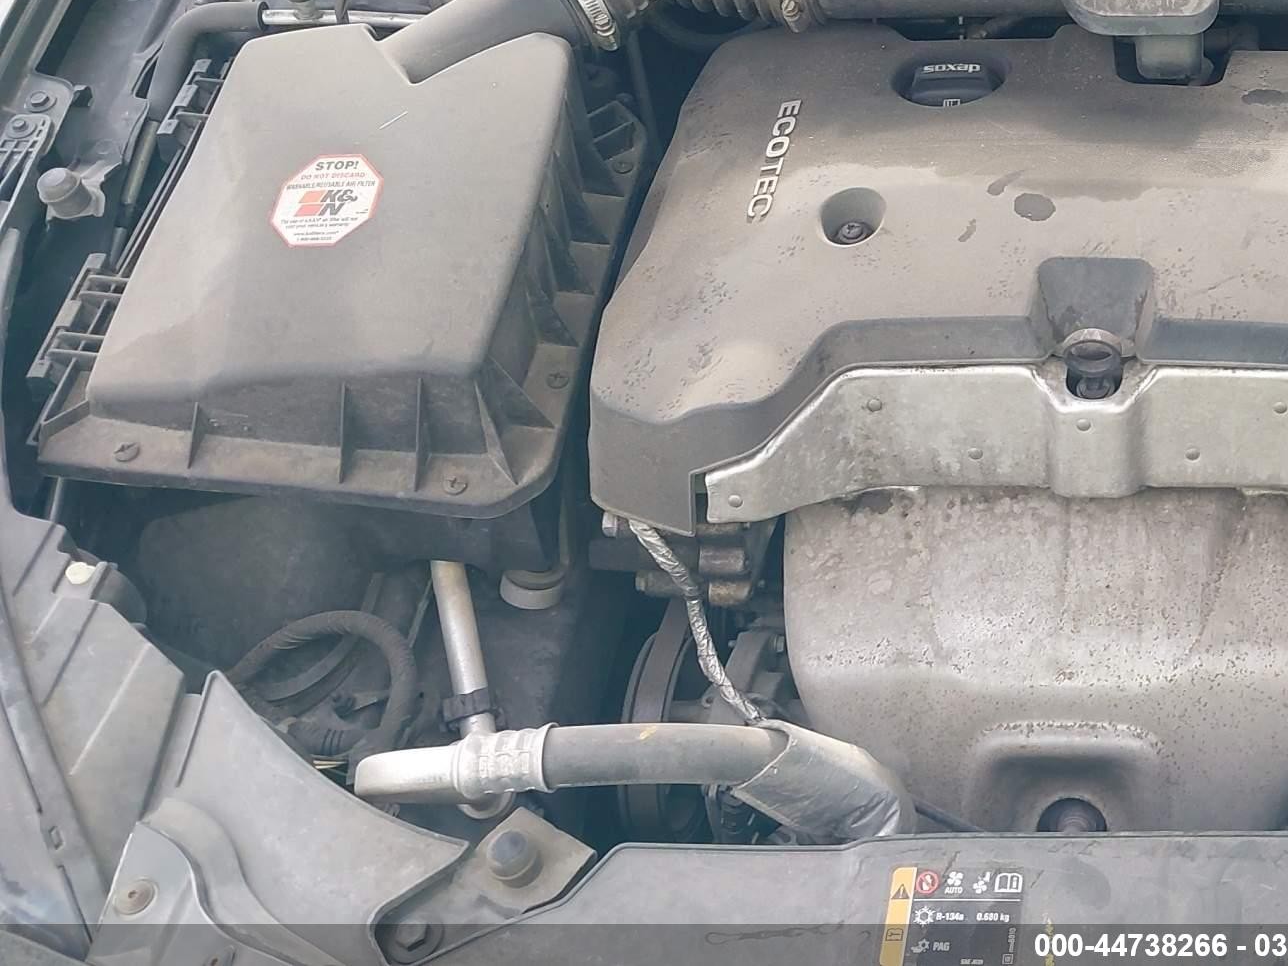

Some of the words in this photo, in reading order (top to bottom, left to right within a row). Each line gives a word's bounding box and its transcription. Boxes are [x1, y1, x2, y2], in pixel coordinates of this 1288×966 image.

[922, 63, 981, 74] dexos
[747, 99, 802, 218] ECOTEC
[315, 160, 360, 172] STOP!
[944, 886, 963, 894] AUTO
[1000, 912, 1010, 923] kg
[932, 942, 950, 951] PAG
